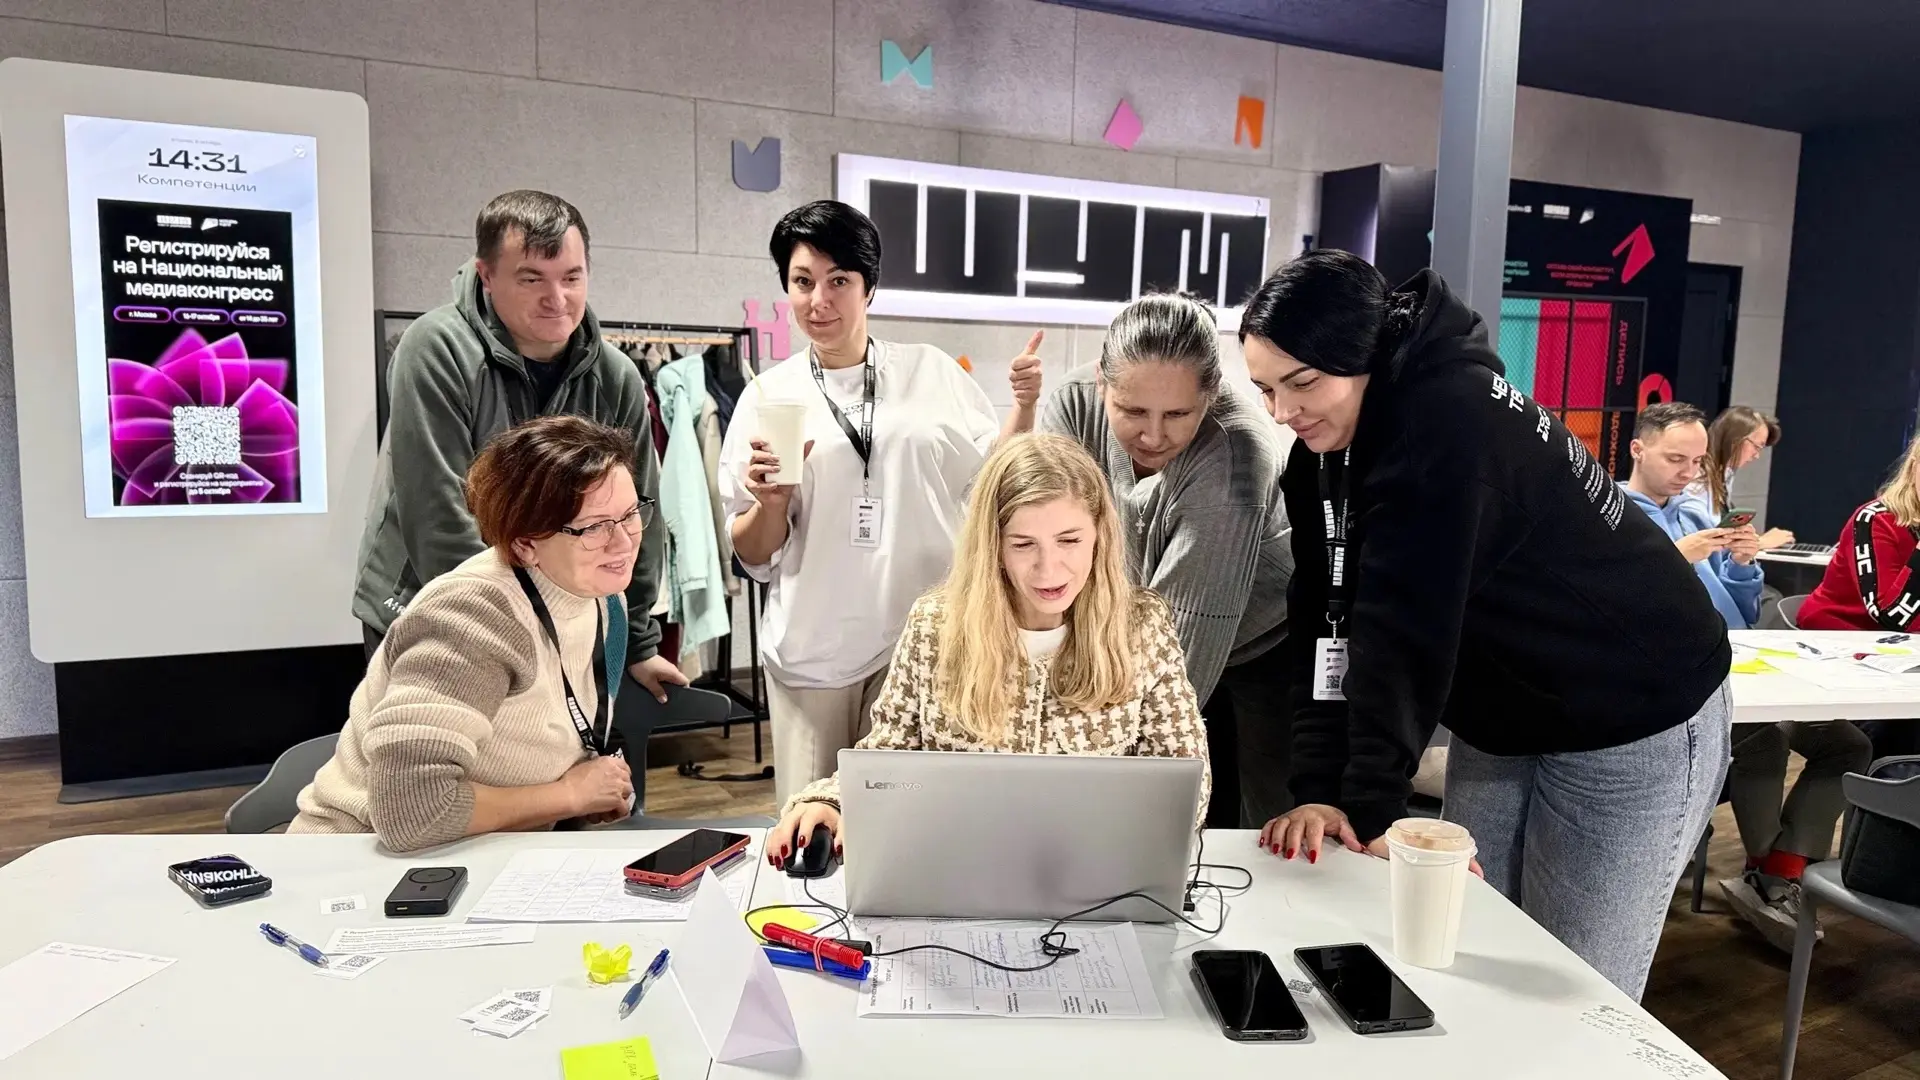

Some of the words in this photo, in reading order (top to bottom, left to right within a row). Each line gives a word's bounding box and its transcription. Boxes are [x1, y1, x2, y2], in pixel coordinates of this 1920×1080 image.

[148, 148, 247, 174] 14:31
[137, 174, 257, 193] Компетенции
[125, 235, 270, 262] Регистрируйся
[113, 260, 137, 274] на
[141, 258, 283, 282] Национальный
[126, 282, 274, 303] медиаконгресс
[1615, 319, 1629, 386] ДЕЛИСЬ
[864, 779, 923, 790] Lenovo
